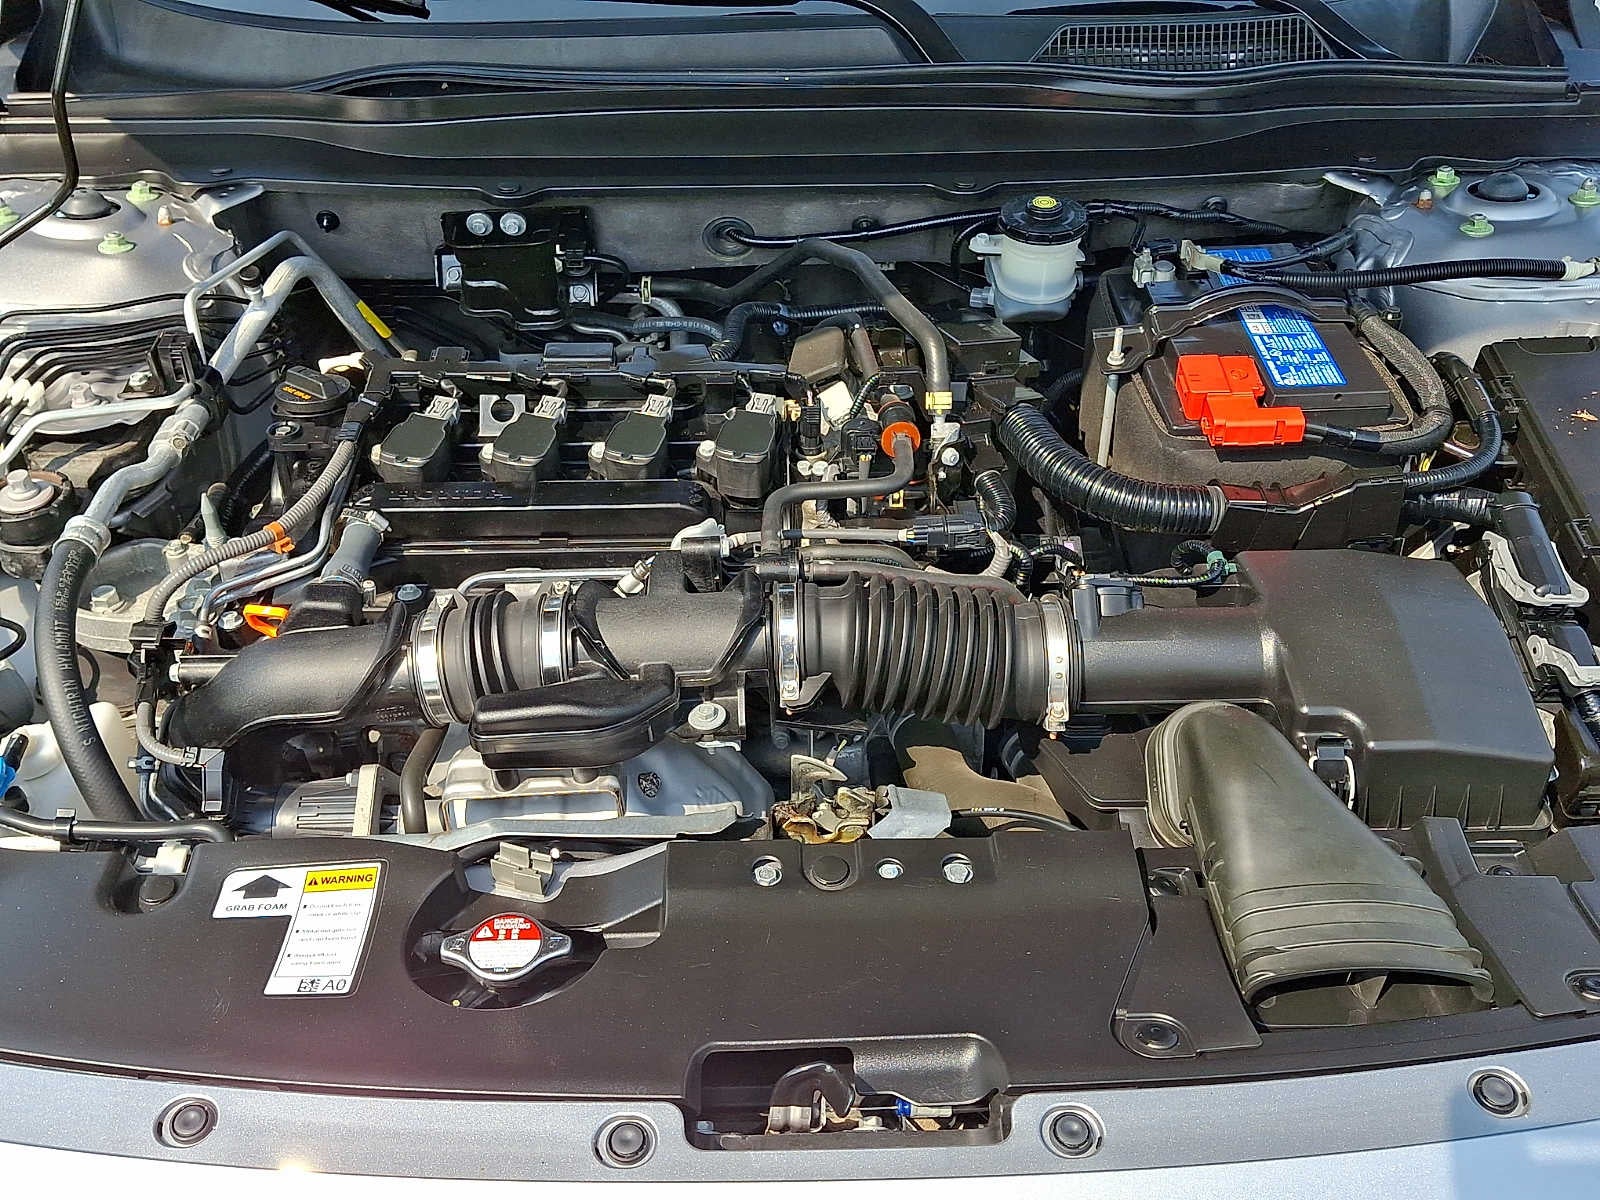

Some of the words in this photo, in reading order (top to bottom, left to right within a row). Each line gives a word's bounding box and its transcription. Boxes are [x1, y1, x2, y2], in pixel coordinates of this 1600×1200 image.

[320, 874, 374, 885] WARNING
[225, 904, 255, 912] GRAB
[257, 903, 288, 911] FOAM
